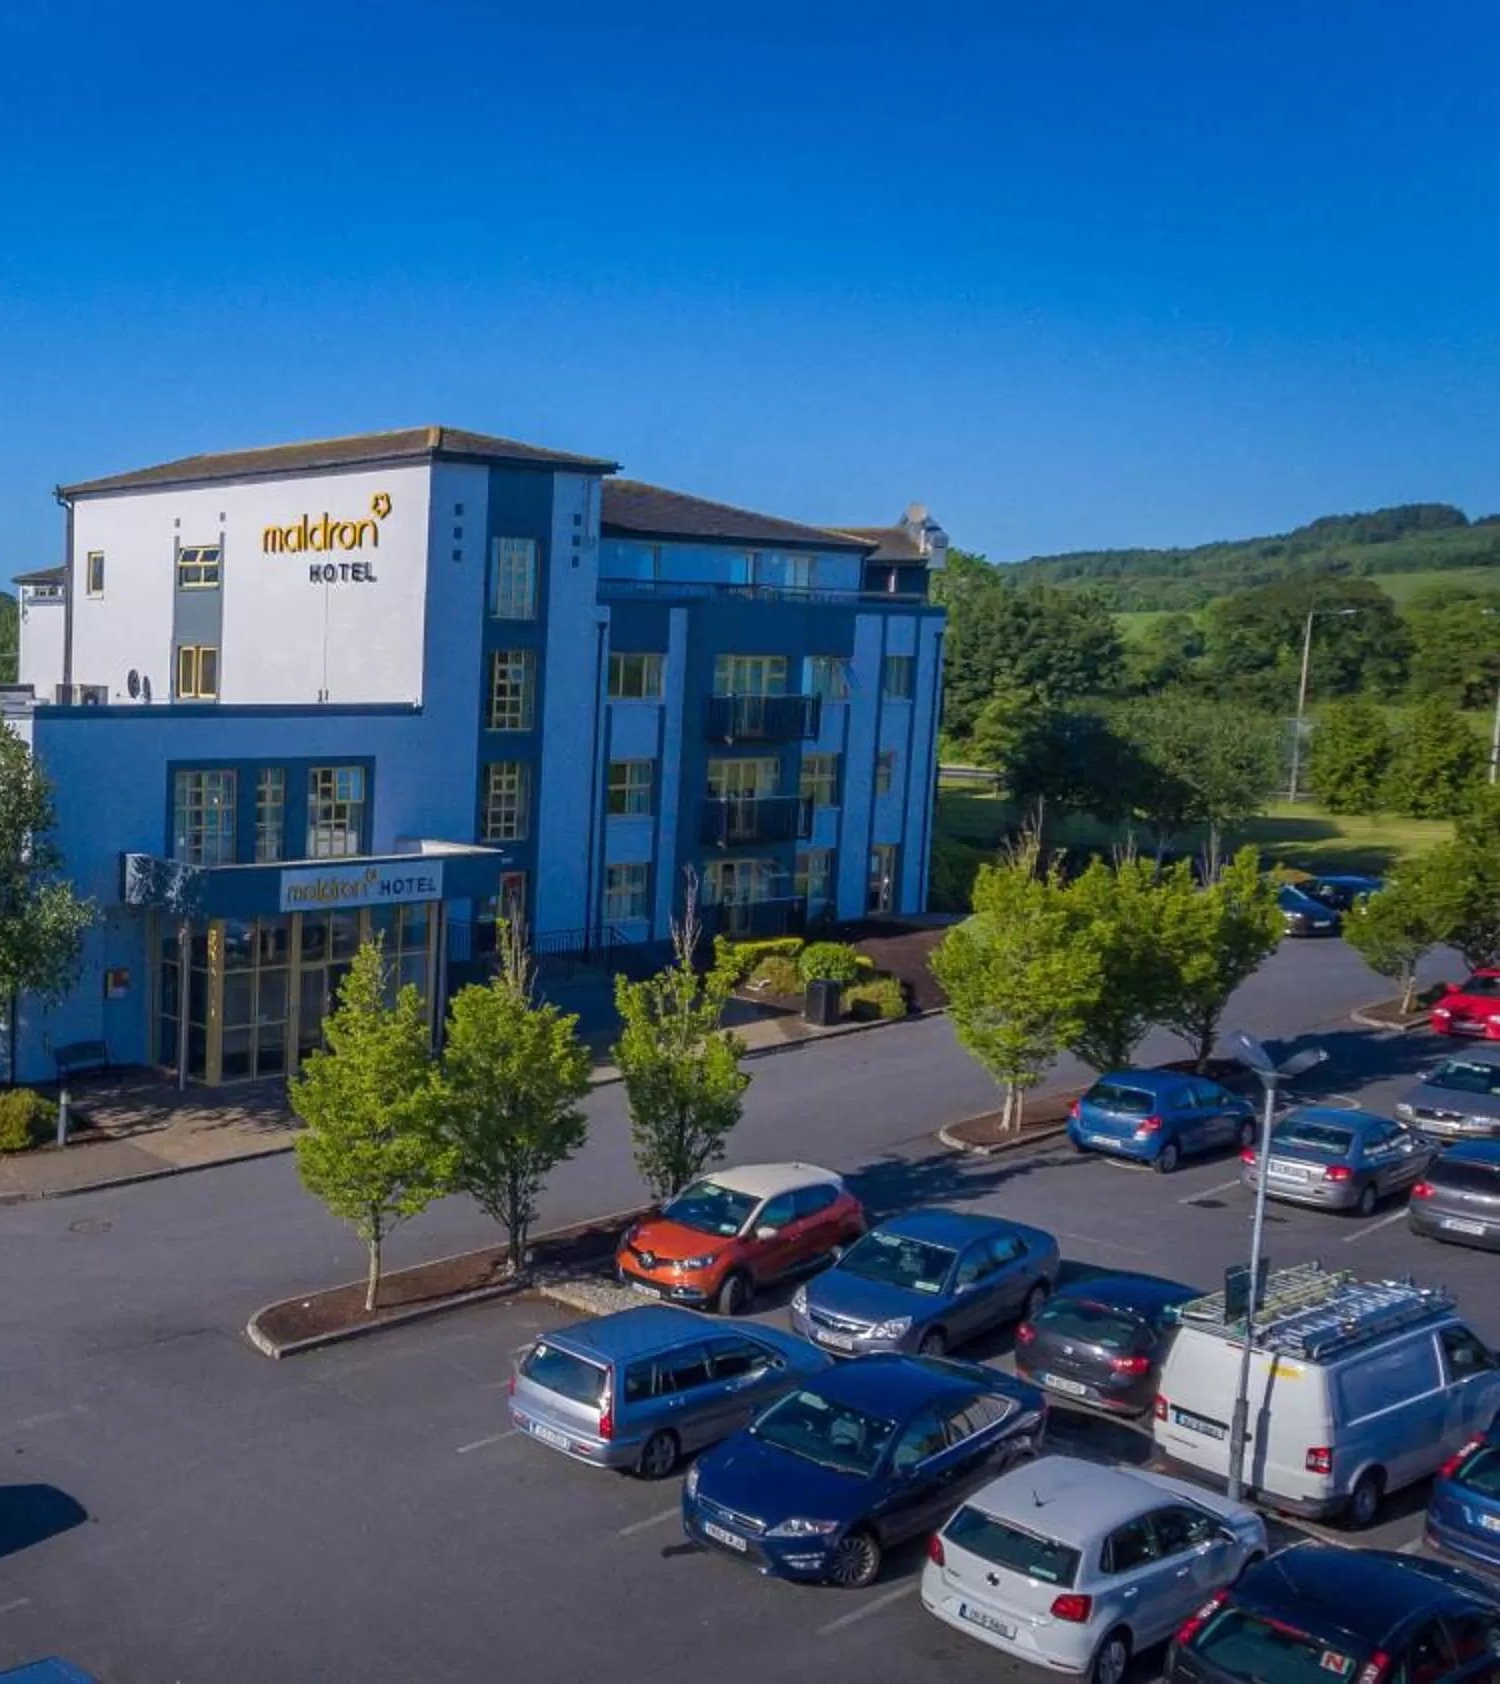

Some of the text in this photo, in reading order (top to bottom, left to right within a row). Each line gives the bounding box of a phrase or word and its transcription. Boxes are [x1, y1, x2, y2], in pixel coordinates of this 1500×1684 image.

[262, 511, 379, 554] maldron
[309, 561, 378, 584] HOTEL
[286, 876, 437, 902] maldron HOTEL
